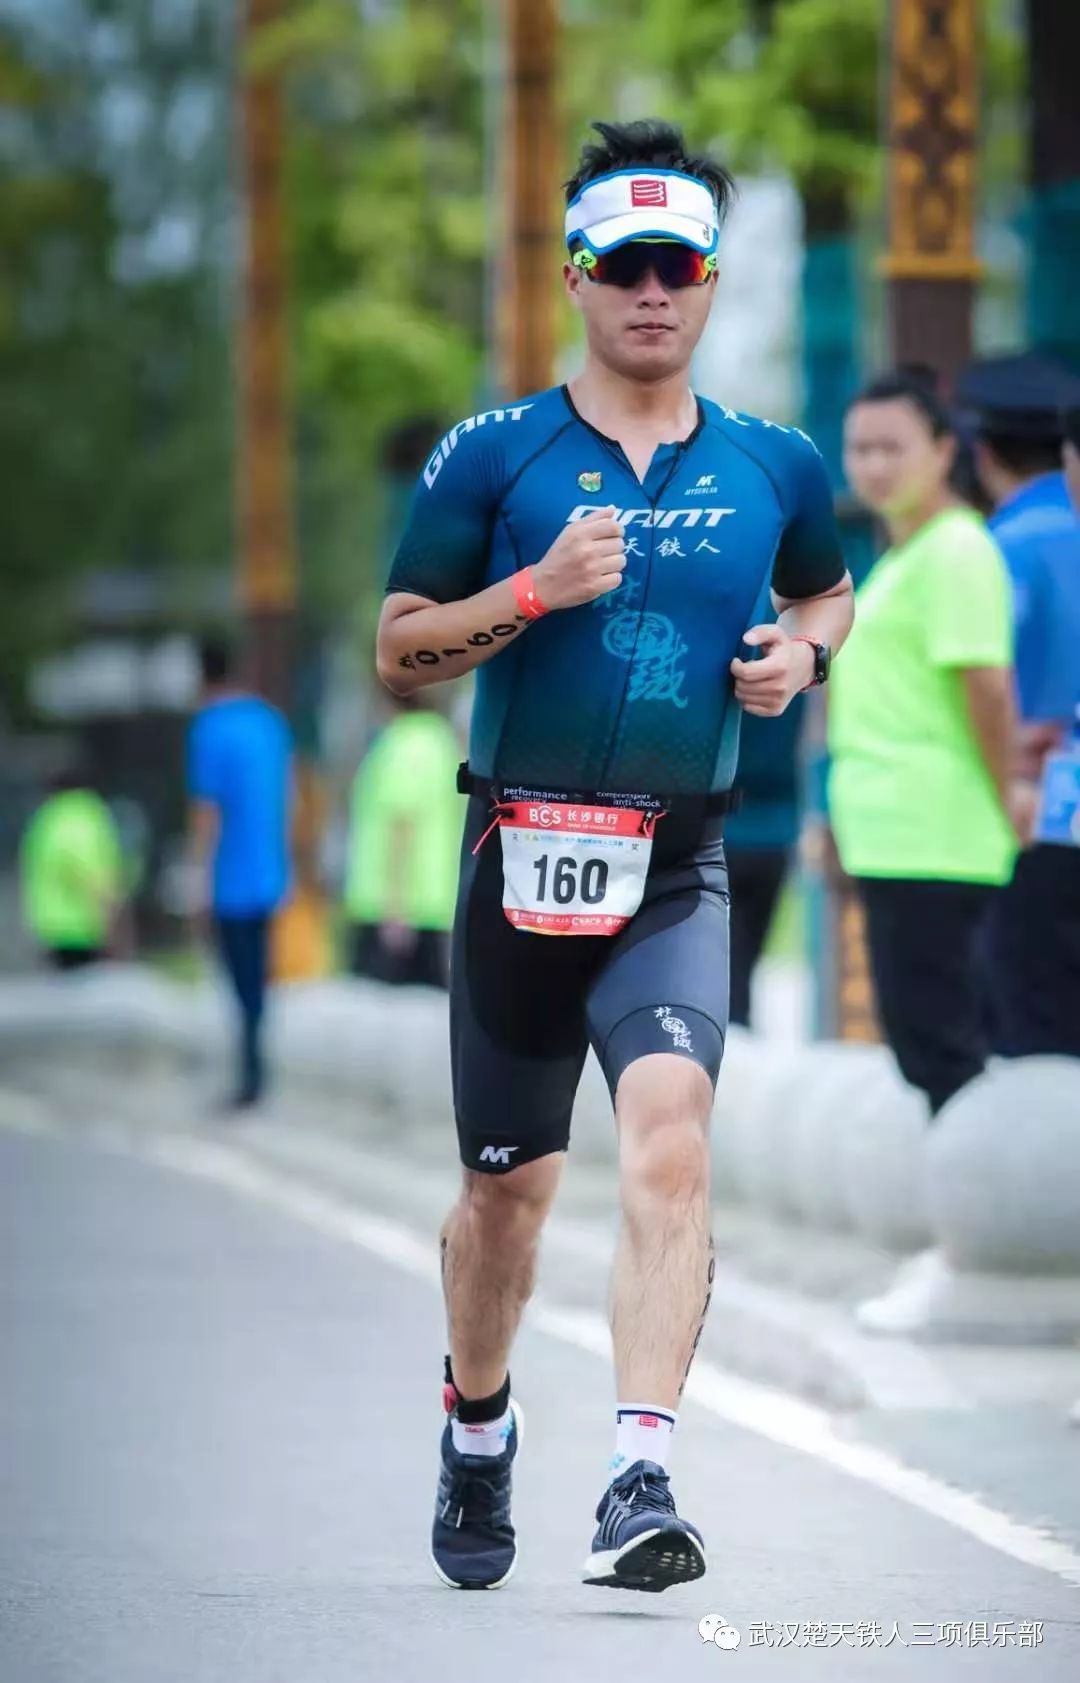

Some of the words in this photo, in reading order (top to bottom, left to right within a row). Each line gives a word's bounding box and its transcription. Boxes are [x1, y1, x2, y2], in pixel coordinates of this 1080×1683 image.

[423, 403, 536, 490] GIANT
[503, 786, 568, 801] performance
[529, 805, 562, 827] BCS
[567, 809, 618, 825] 长沙银行
[533, 854, 609, 905] 160
